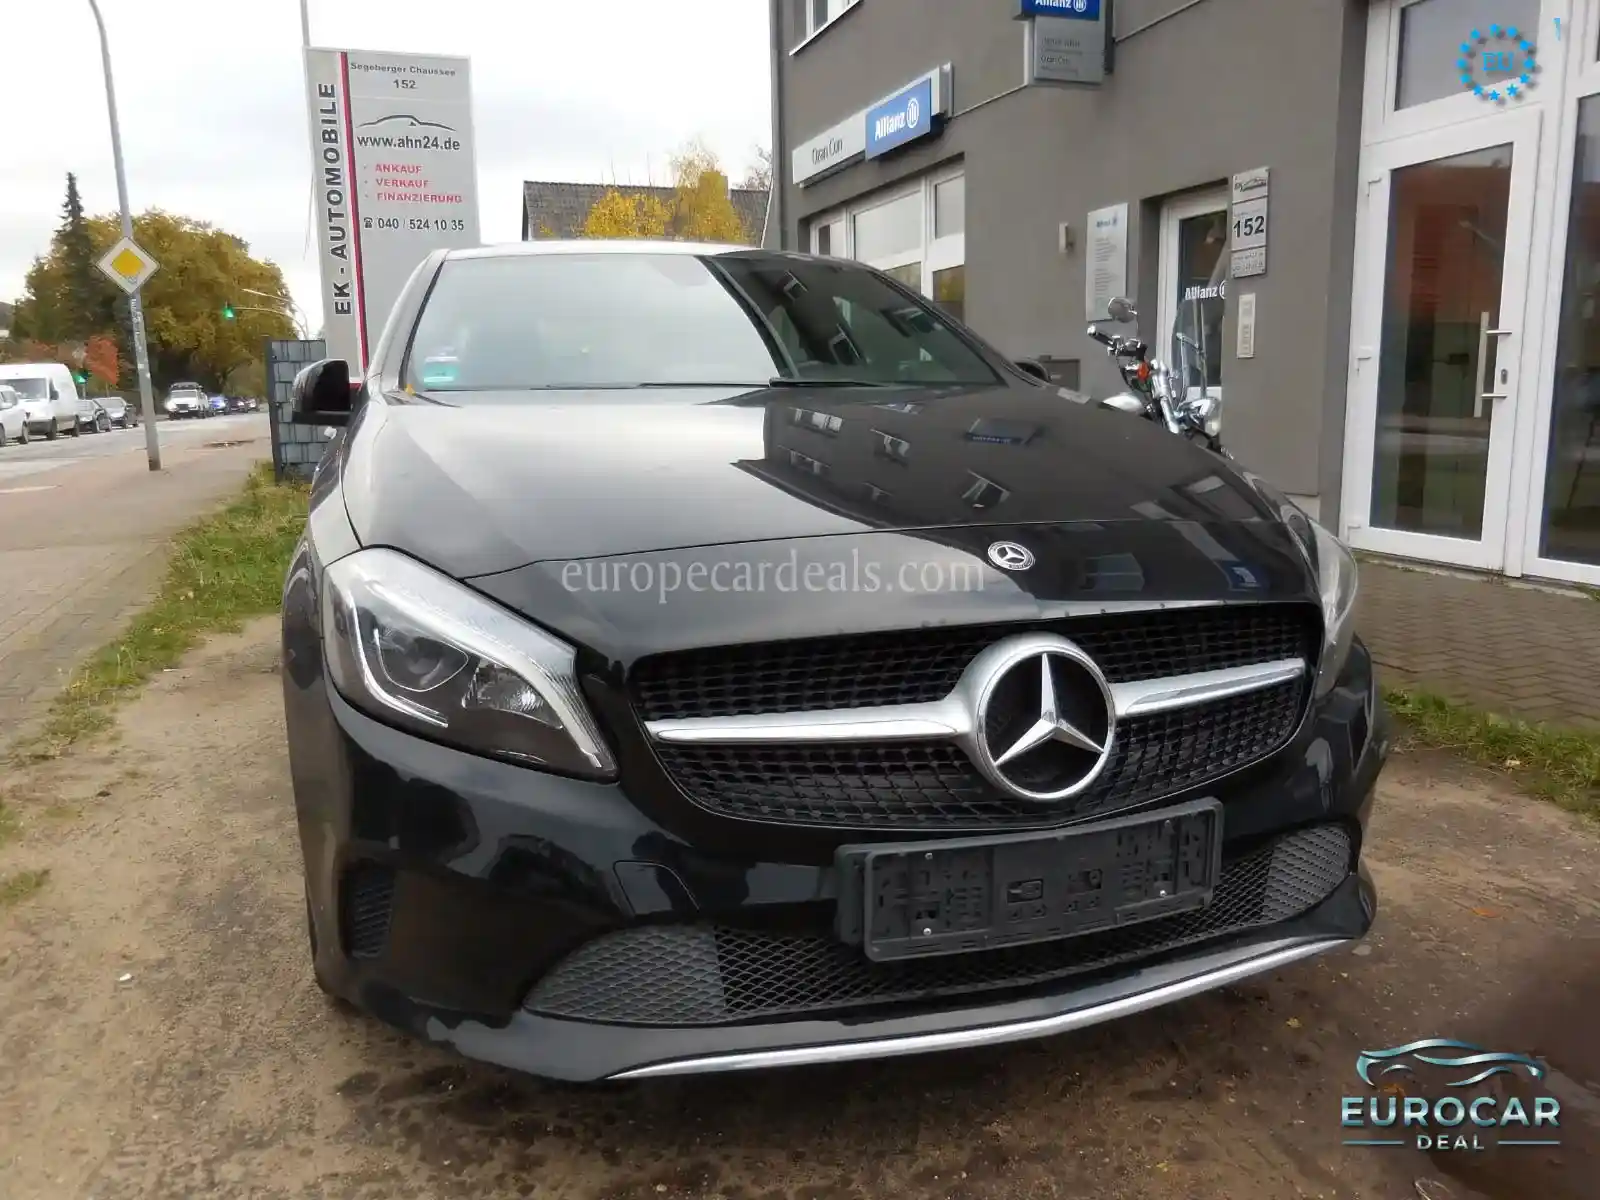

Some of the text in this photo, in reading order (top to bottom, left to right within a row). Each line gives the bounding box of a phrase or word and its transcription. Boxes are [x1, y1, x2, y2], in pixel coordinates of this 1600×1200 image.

[350, 62, 456, 76] Segeberger Chaussee
[393, 79, 417, 89] 152
[874, 111, 906, 142] Allianz
[357, 135, 461, 150] www.ahn24.de
[318, 83, 348, 260] AUTOMOBILE
[374, 163, 423, 174] ANKAUF
[375, 178, 430, 189] VERKAUF
[376, 191, 463, 204] FINANZIERUNG
[377, 217, 400, 230] 040
[409, 219, 430, 231] 524
[433, 220, 447, 231] 10
[451, 220, 465, 231] 35
[1233, 215, 1265, 238] 152
[333, 282, 351, 315] EK
[1184, 285, 1218, 300] Allianz
